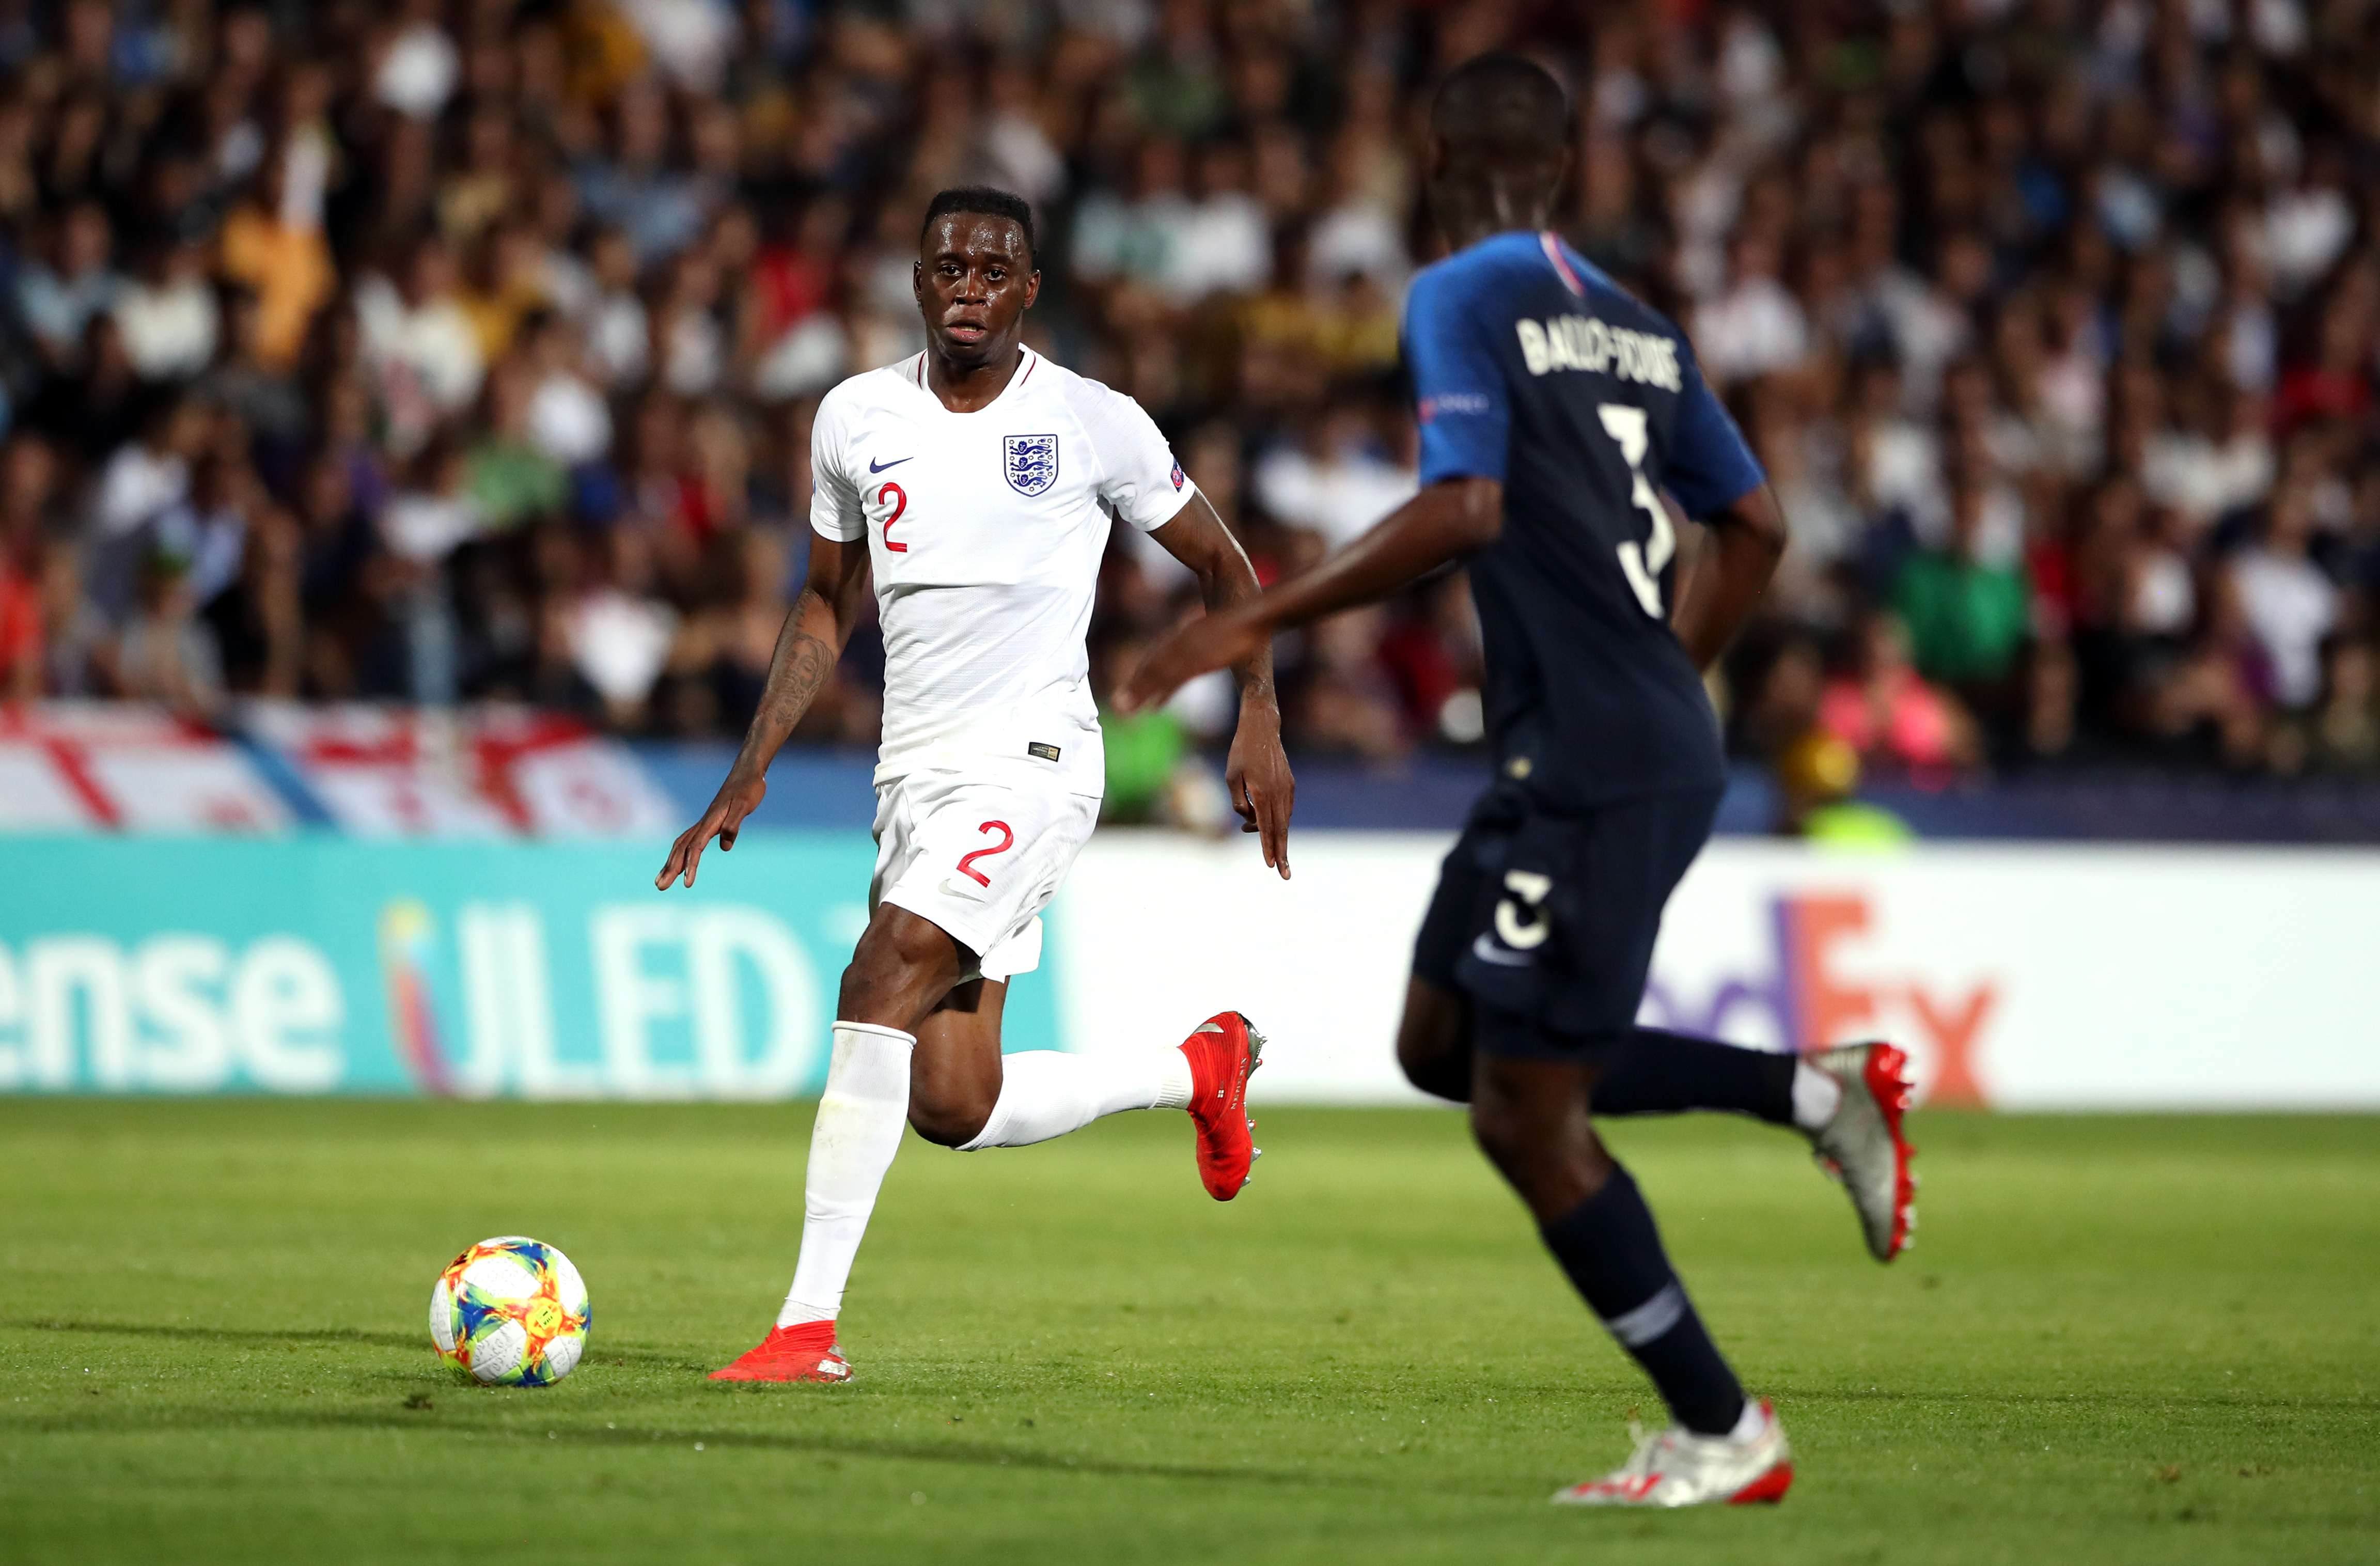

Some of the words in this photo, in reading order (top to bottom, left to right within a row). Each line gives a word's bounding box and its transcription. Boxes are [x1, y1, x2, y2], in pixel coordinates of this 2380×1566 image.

[879, 481, 908, 553] 2
[1596, 402, 1677, 619] 3
[956, 820, 1014, 888] 2
[1494, 868, 1553, 950] 3
[0, 932, 347, 1094] nse
